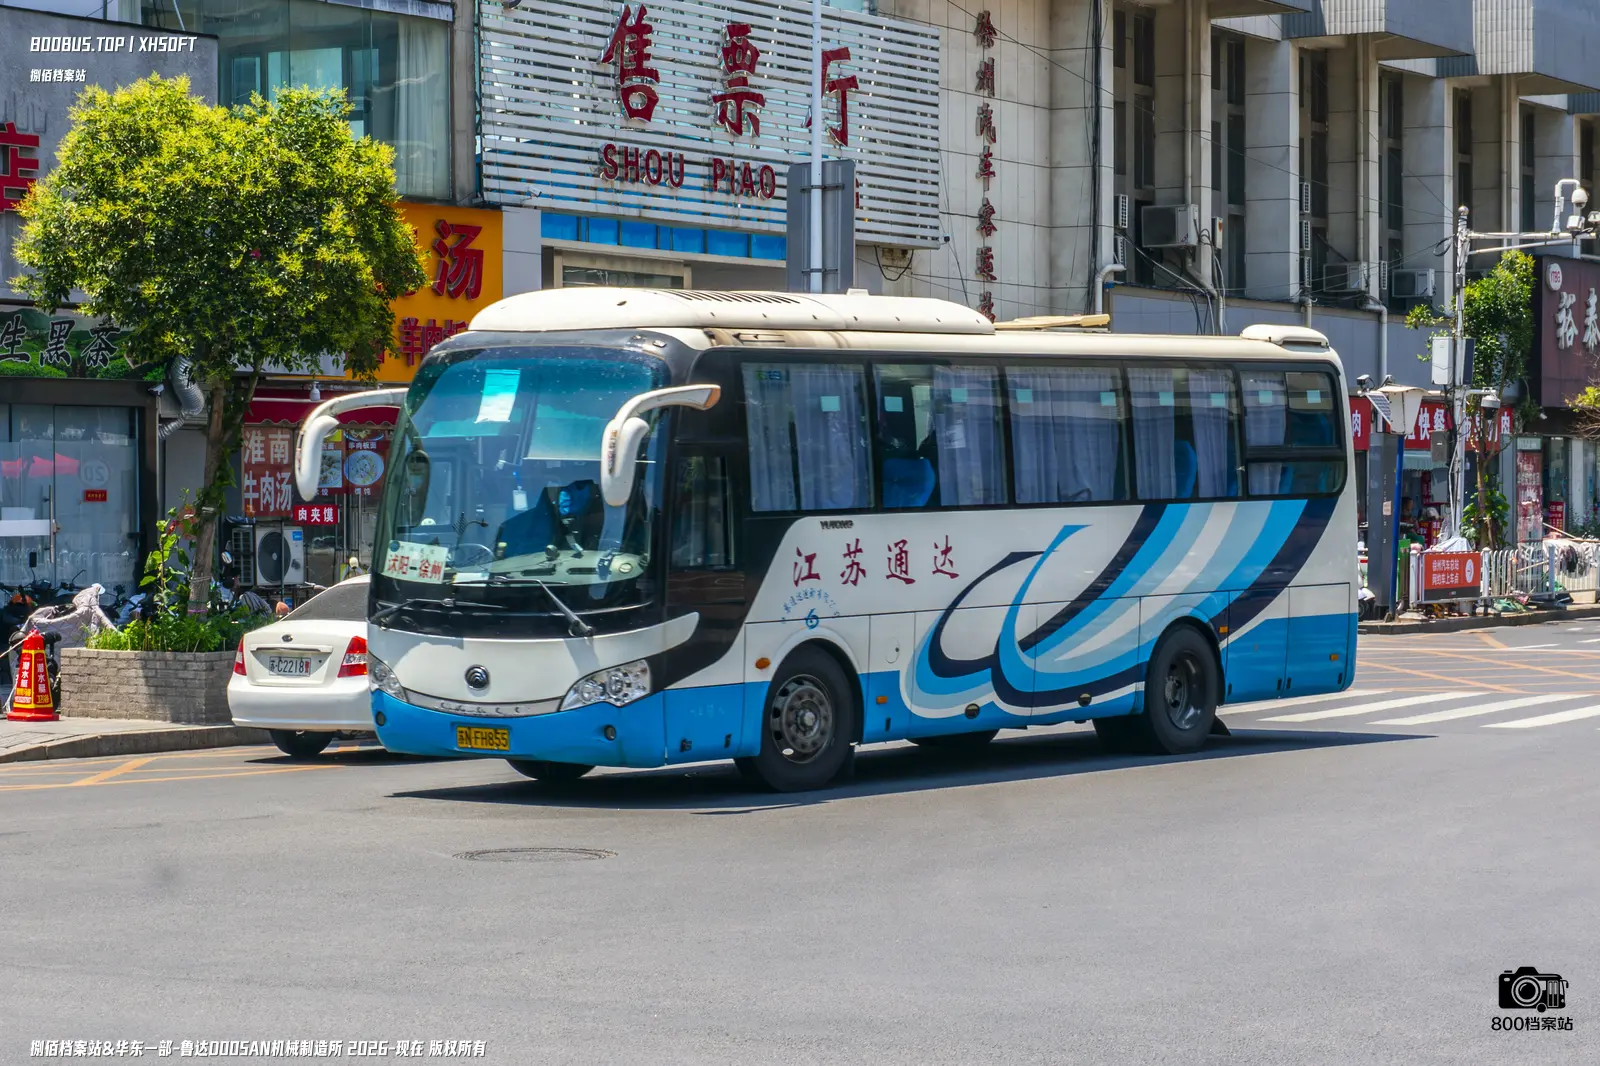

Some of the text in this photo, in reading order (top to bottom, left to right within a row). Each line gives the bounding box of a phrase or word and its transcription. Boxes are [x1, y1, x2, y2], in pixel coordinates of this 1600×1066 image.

[602, 4, 859, 147] 售票厅
[600, 143, 777, 200] SHOU PIAO
[432, 219, 485, 300] 汤
[0, 314, 121, 368] 生黑茶
[244, 430, 291, 465] 淮南
[1406, 407, 1446, 440] 快餐
[244, 470, 292, 513] 牛肉汤
[298, 506, 334, 523] 肉夹馍
[793, 535, 960, 588] 江苏通达
